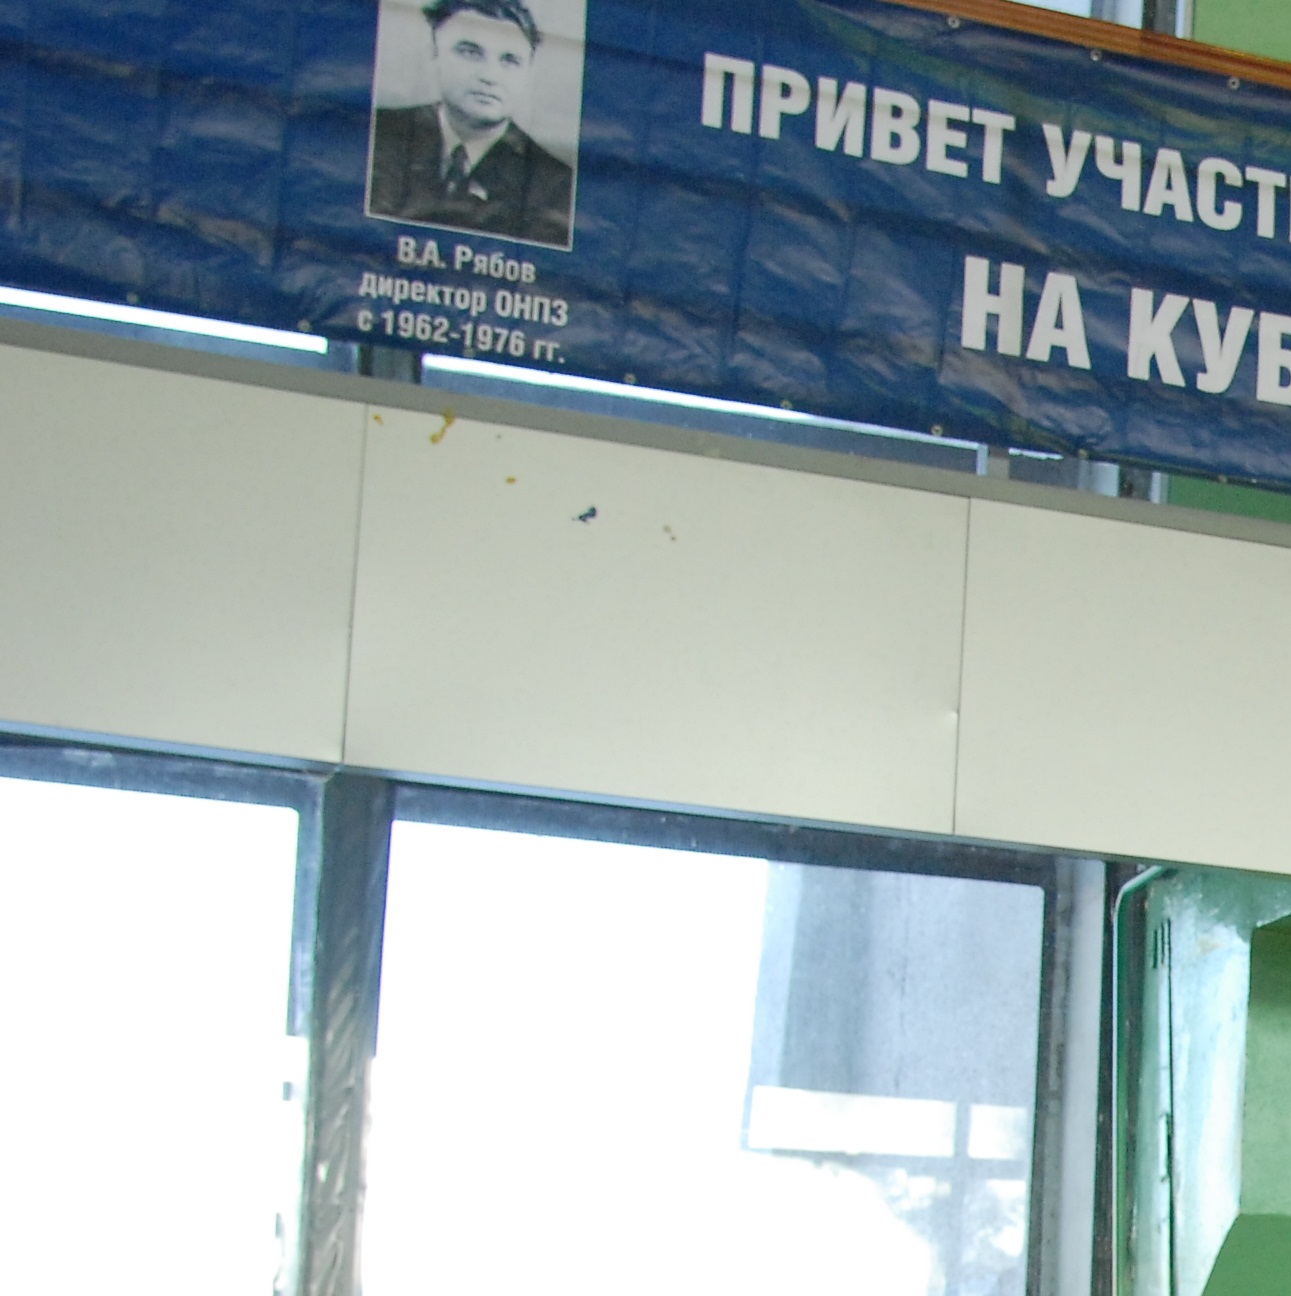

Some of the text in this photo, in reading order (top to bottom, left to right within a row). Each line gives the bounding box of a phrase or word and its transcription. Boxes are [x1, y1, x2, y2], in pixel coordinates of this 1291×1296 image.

[702, 52, 1015, 184] ПРИВЕТ
[397, 235, 536, 284] В.А. Рябов
[358, 272, 570, 327] директор ОНПЗ
[960, 254, 1091, 370] НА
[357, 309, 566, 365] с 1962-1976 гг.
